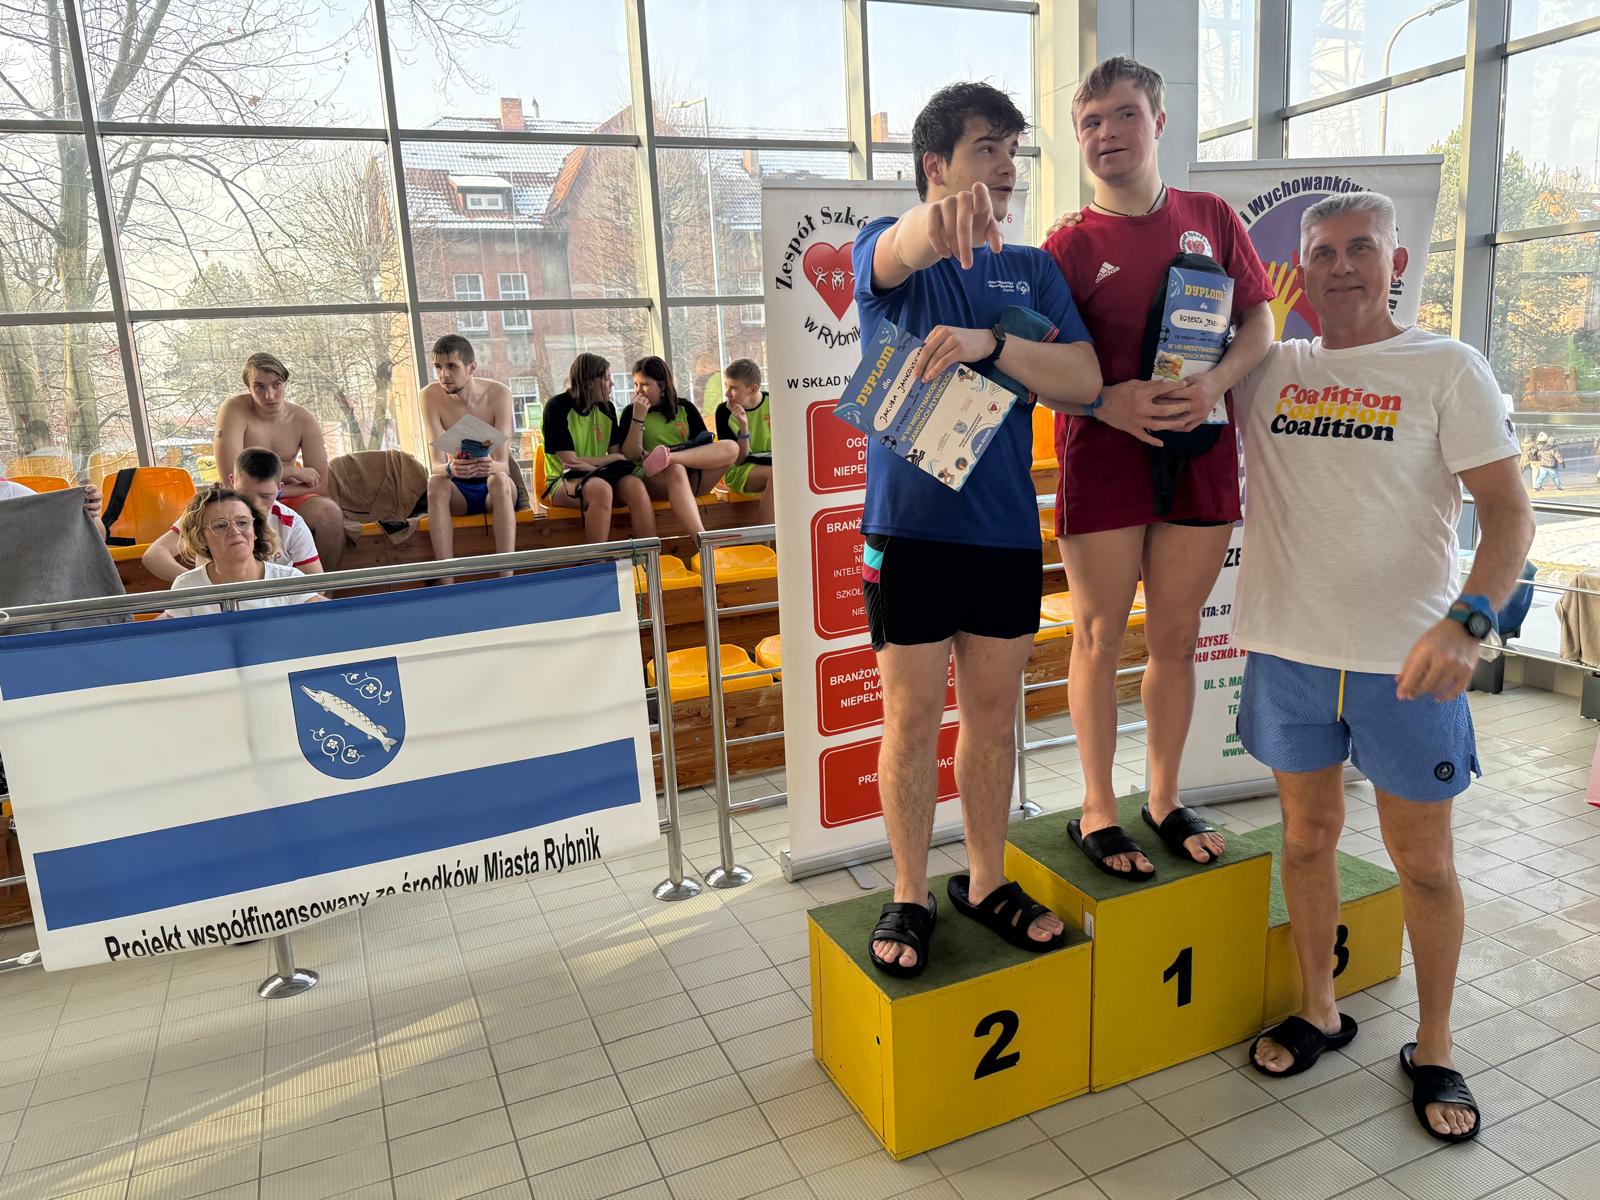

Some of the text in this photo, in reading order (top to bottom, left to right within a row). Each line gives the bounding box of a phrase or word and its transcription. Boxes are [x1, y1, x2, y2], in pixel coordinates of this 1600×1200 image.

[1239, 211, 1251, 225] i
[776, 206, 869, 290] Zespół Szkó
[1184, 285, 1224, 301] DYPLOM
[804, 316, 818, 332] w
[787, 378, 799, 389] W
[802, 376, 841, 388] SKŁAD
[856, 346, 895, 407] DYPLOM
[882, 378, 891, 390] dla
[1280, 384, 1402, 411] Coalition
[880, 394, 898, 423] JAKUBA
[1275, 399, 1398, 427] Coalition
[1271, 414, 1394, 441] Coalition
[846, 434, 868, 448] OGÓ
[833, 464, 867, 477] NIEPE
[826, 517, 862, 533] BRANŻ
[1224, 547, 1241, 568] ZE
[834, 566, 864, 578] INTELE
[836, 588, 864, 599] SZKOŁ
[1220, 604, 1232, 615] 37
[1196, 634, 1229, 648] RZYSZE
[1210, 646, 1238, 660] SZKÓŁ
[830, 668, 880, 686] BRANŻOW
[1228, 676, 1243, 687] MA
[840, 691, 882, 708] NIEPEŁN
[1222, 748, 1248, 757] www.
[858, 773, 878, 785] PRZ
[104, 924, 186, 961] Projekt
[187, 891, 370, 945] współfinansowany
[402, 860, 479, 893] środków
[484, 846, 540, 882] Miasta
[544, 827, 602, 873] Rybnik
[1163, 946, 1192, 1008] 1
[973, 1010, 1020, 1080] 2
